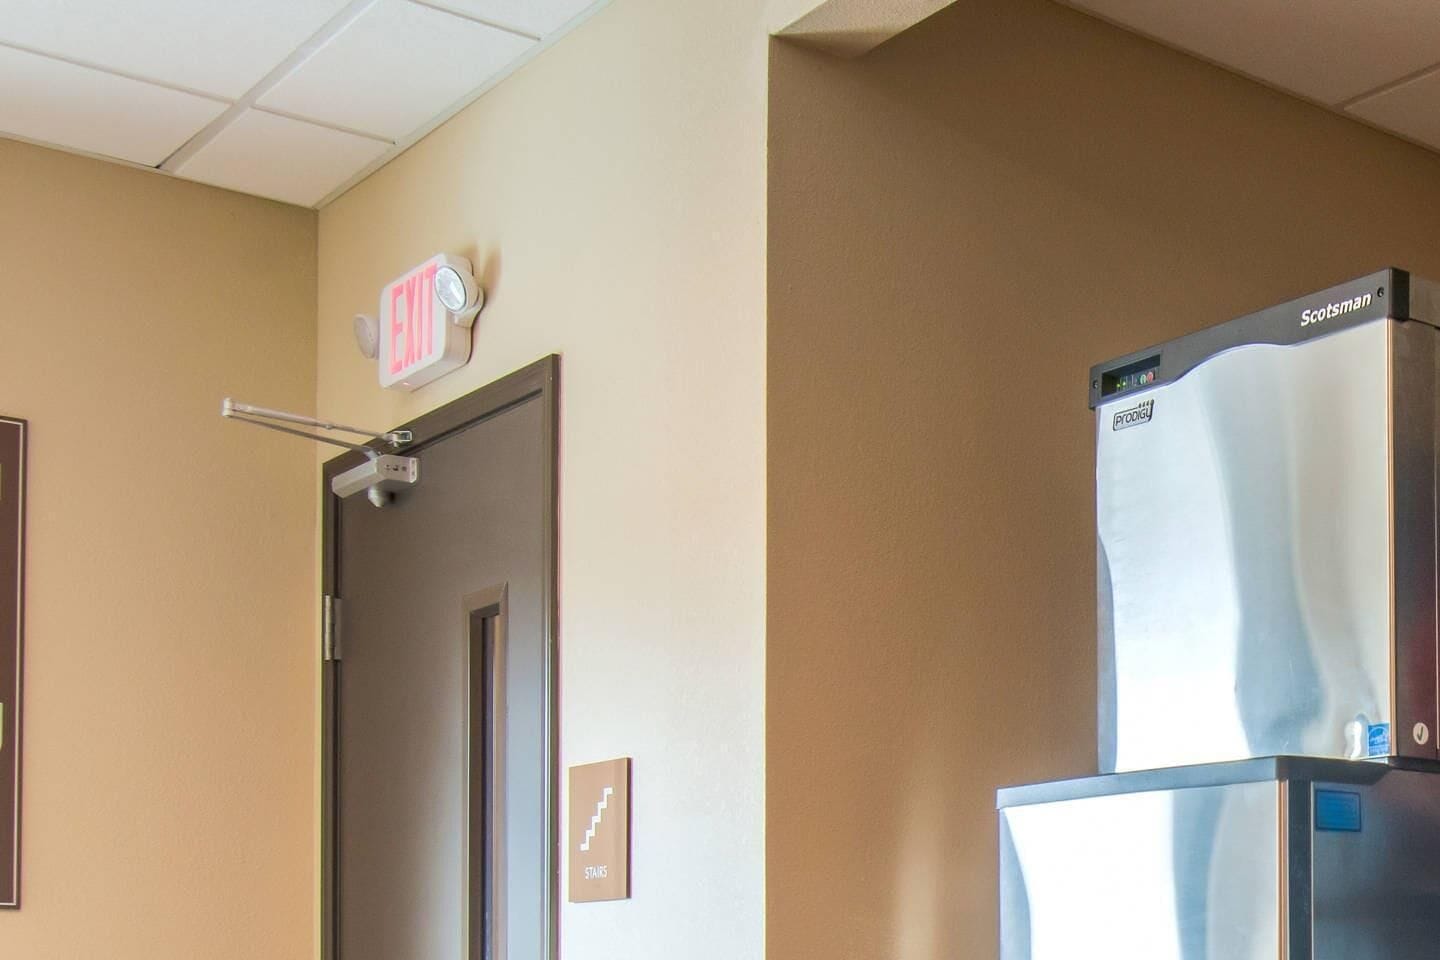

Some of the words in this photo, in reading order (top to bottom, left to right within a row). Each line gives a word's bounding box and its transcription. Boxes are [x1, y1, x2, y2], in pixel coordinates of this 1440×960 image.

[390, 262, 438, 375] EXIT
[1301, 293, 1372, 327] Scotsman
[585, 865, 608, 879] STAIRS
